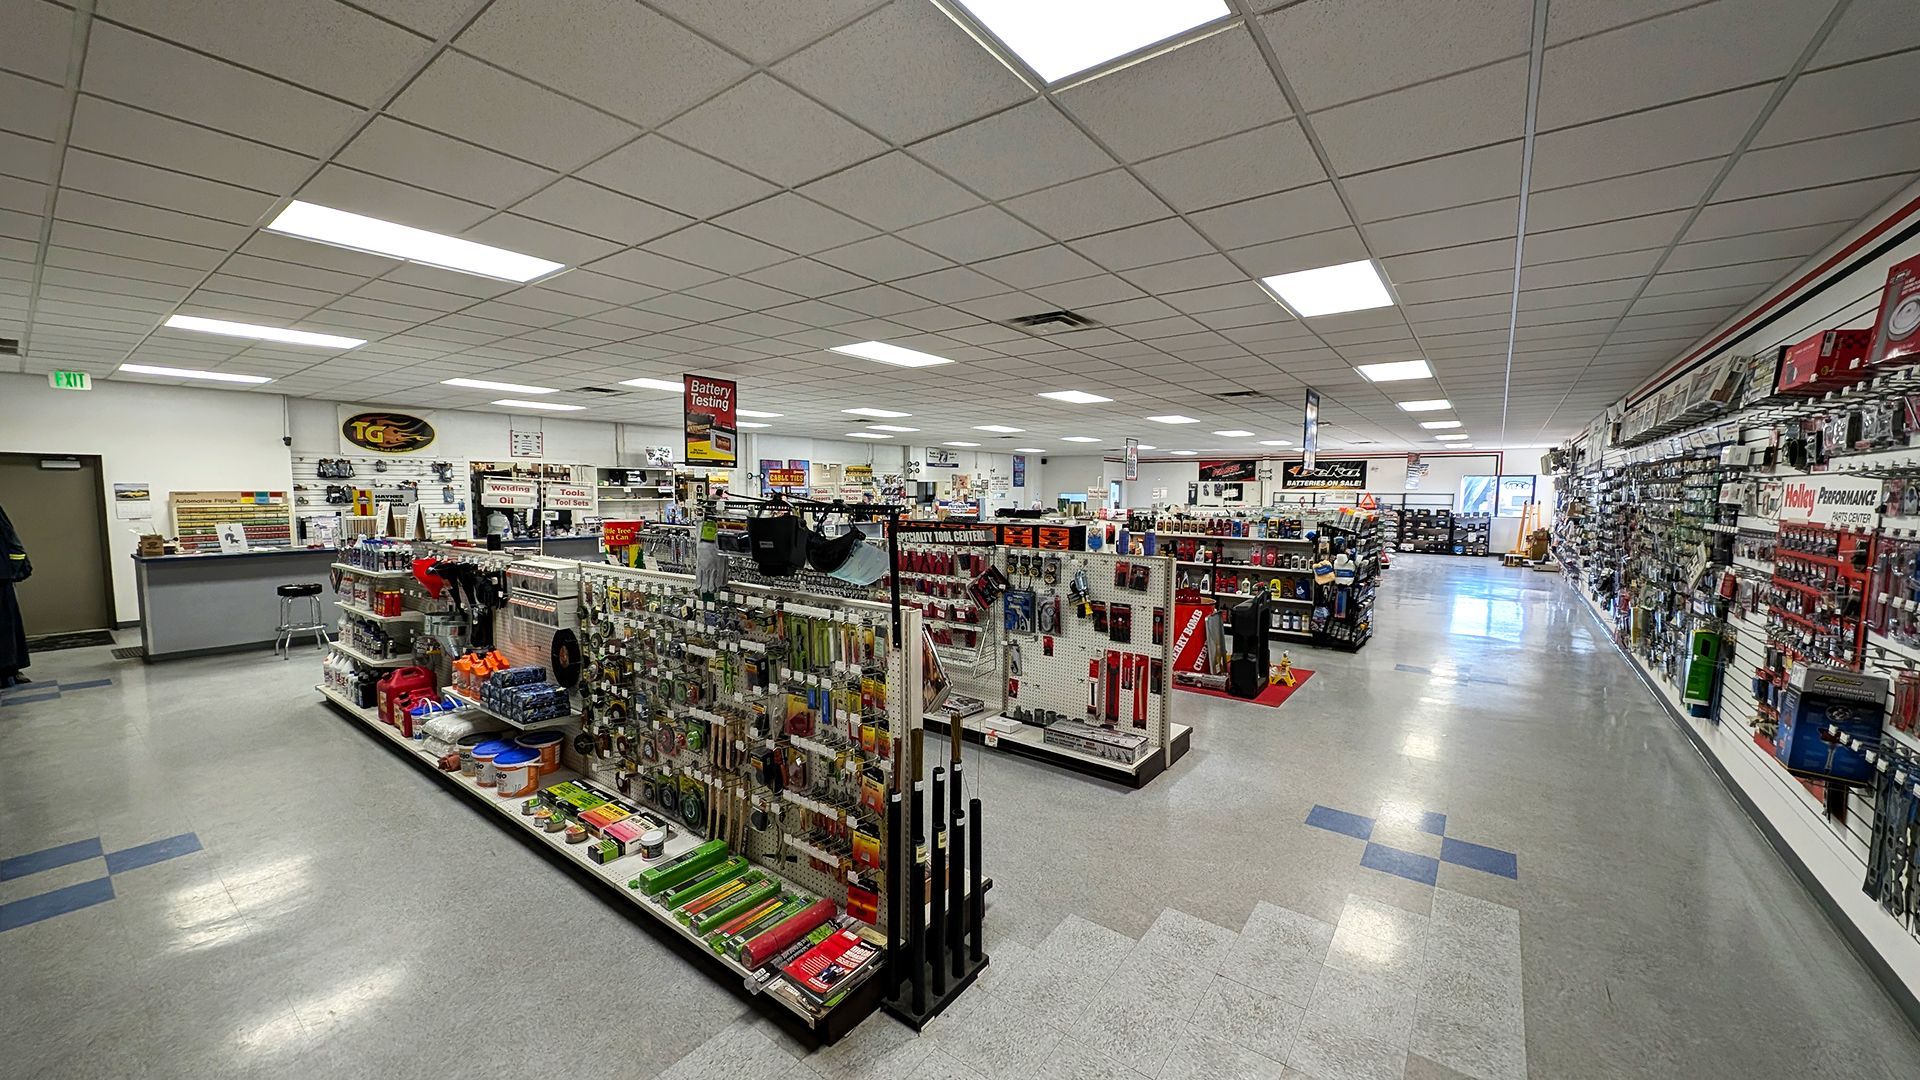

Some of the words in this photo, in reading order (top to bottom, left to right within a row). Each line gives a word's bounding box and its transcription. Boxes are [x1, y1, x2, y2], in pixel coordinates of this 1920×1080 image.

[54, 370, 85, 388] EXIT
[691, 380, 731, 399] Battery
[691, 393, 729, 411] Testing
[769, 474, 789, 482] CABLE
[790, 474, 804, 482] TIES
[1340, 479, 1362, 487] SALE!
[491, 485, 530, 493] Welding
[560, 489, 586, 497] Tools
[499, 496, 514, 504] Oil
[1784, 483, 1816, 517] Holley
[1817, 487, 1878, 506] PERFORMANCE
[1832, 511, 1849, 521] PARTS
[1848, 512, 1872, 523] CENTER
[896, 531, 933, 542] SPECIALTY
[933, 530, 952, 542] TOOL
[953, 529, 986, 542] CENTER!
[1182, 609, 1203, 637] BOMB
